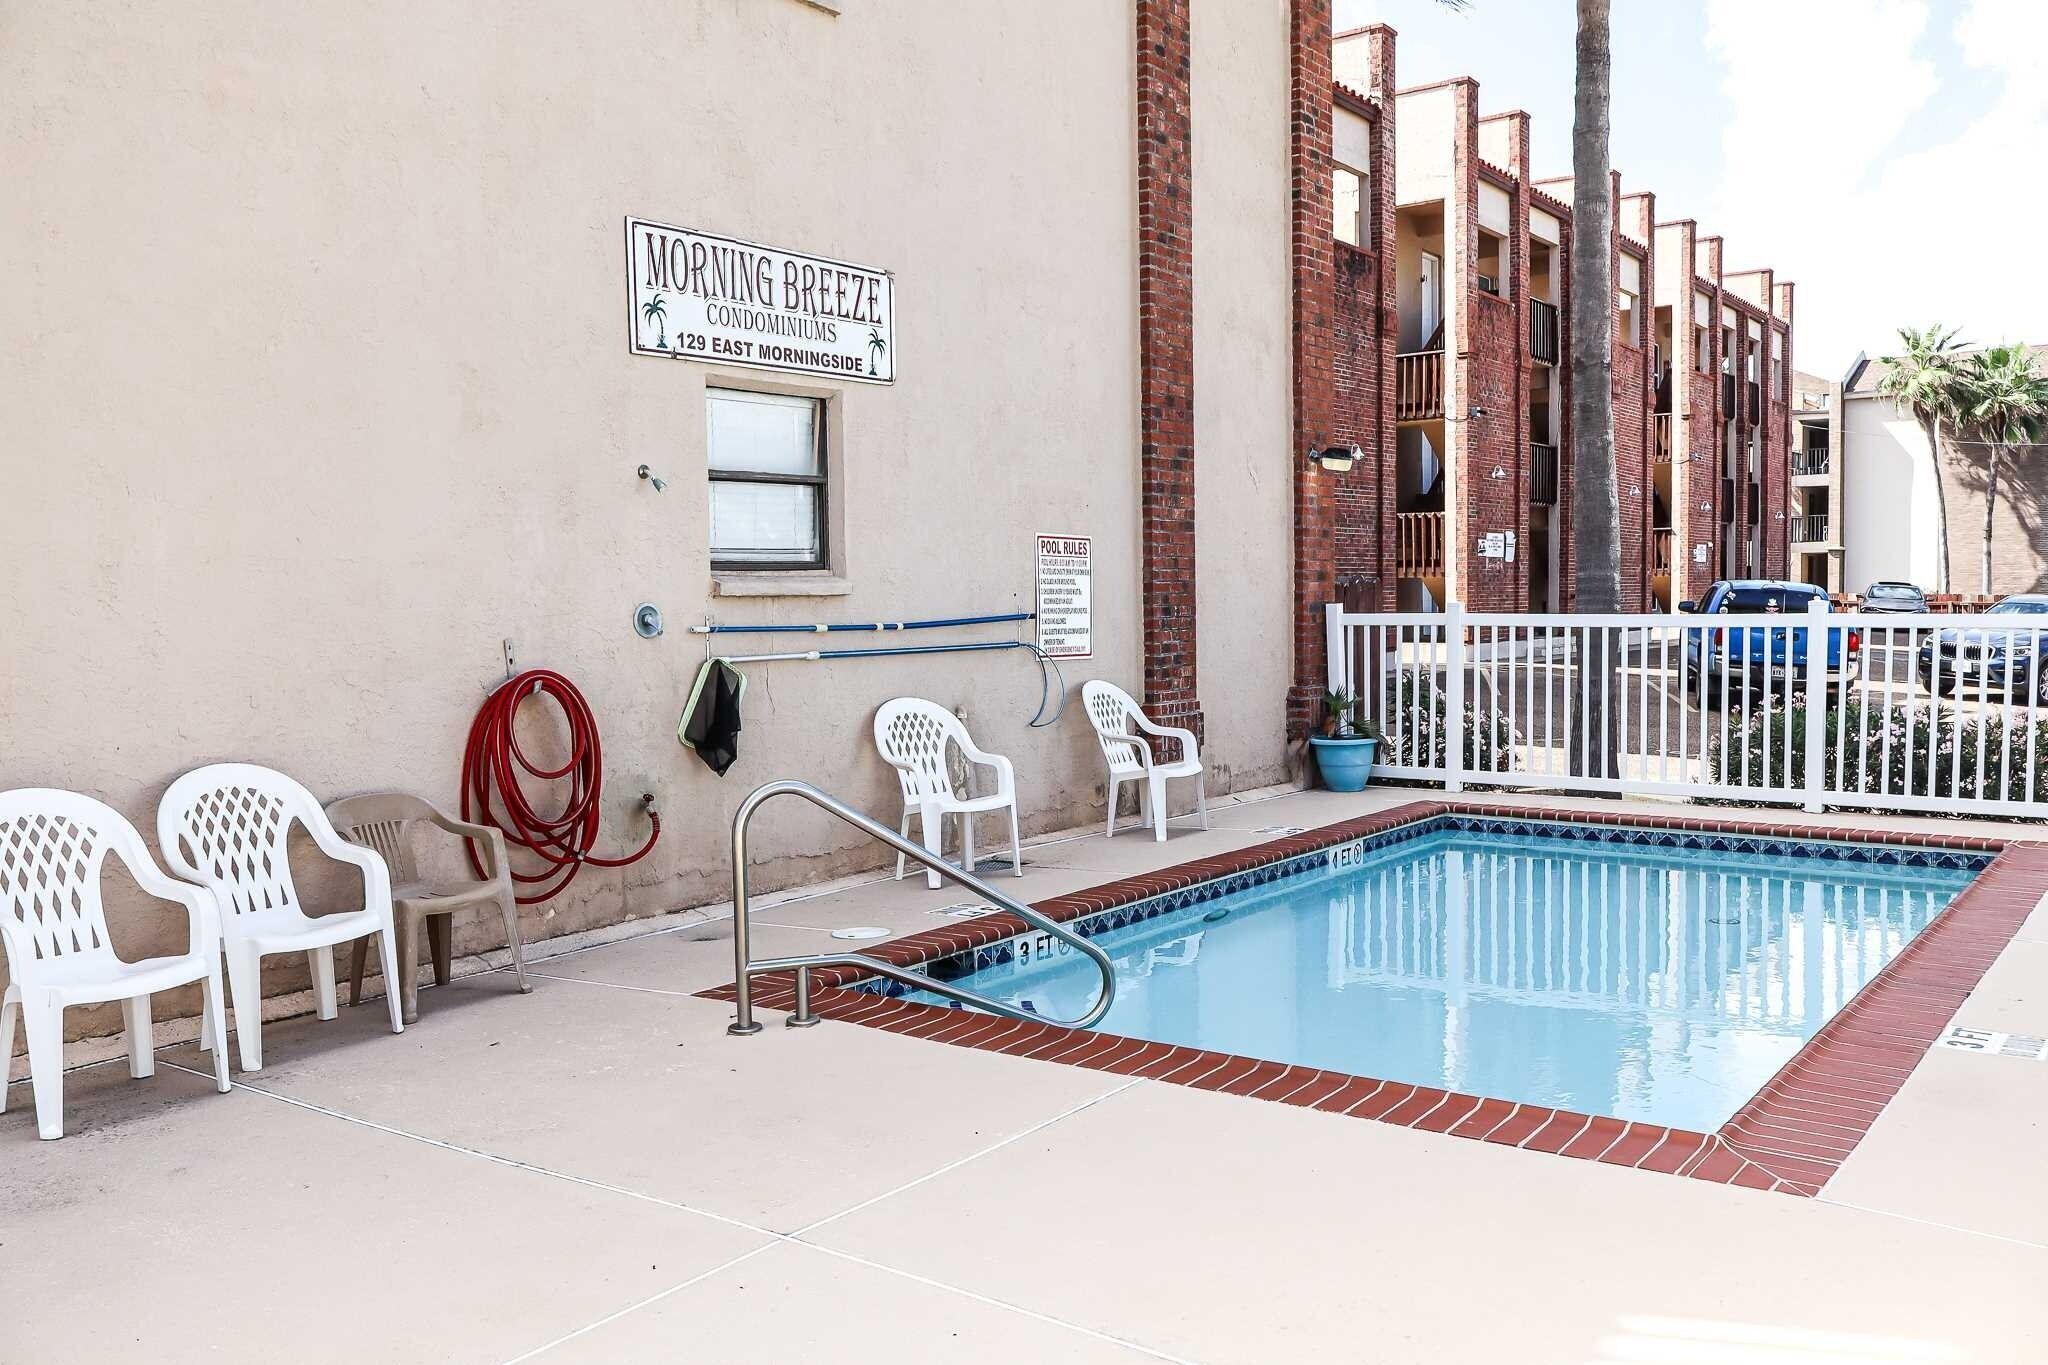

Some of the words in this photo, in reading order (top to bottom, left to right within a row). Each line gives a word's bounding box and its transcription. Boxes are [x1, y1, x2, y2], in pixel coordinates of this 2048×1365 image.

[645, 232, 775, 308] MORNING
[783, 260, 883, 325] BREEZE
[706, 303, 838, 343] CONDOMINIUMS
[677, 332, 706, 350] 129
[712, 337, 754, 357] EAST
[759, 345, 863, 372] MORNINGSIDE
[1040, 540, 1062, 554] POOL
[1063, 541, 1088, 555] RULES
[1946, 1040, 1985, 1049] 3
[1951, 1027, 1993, 1042] FT
